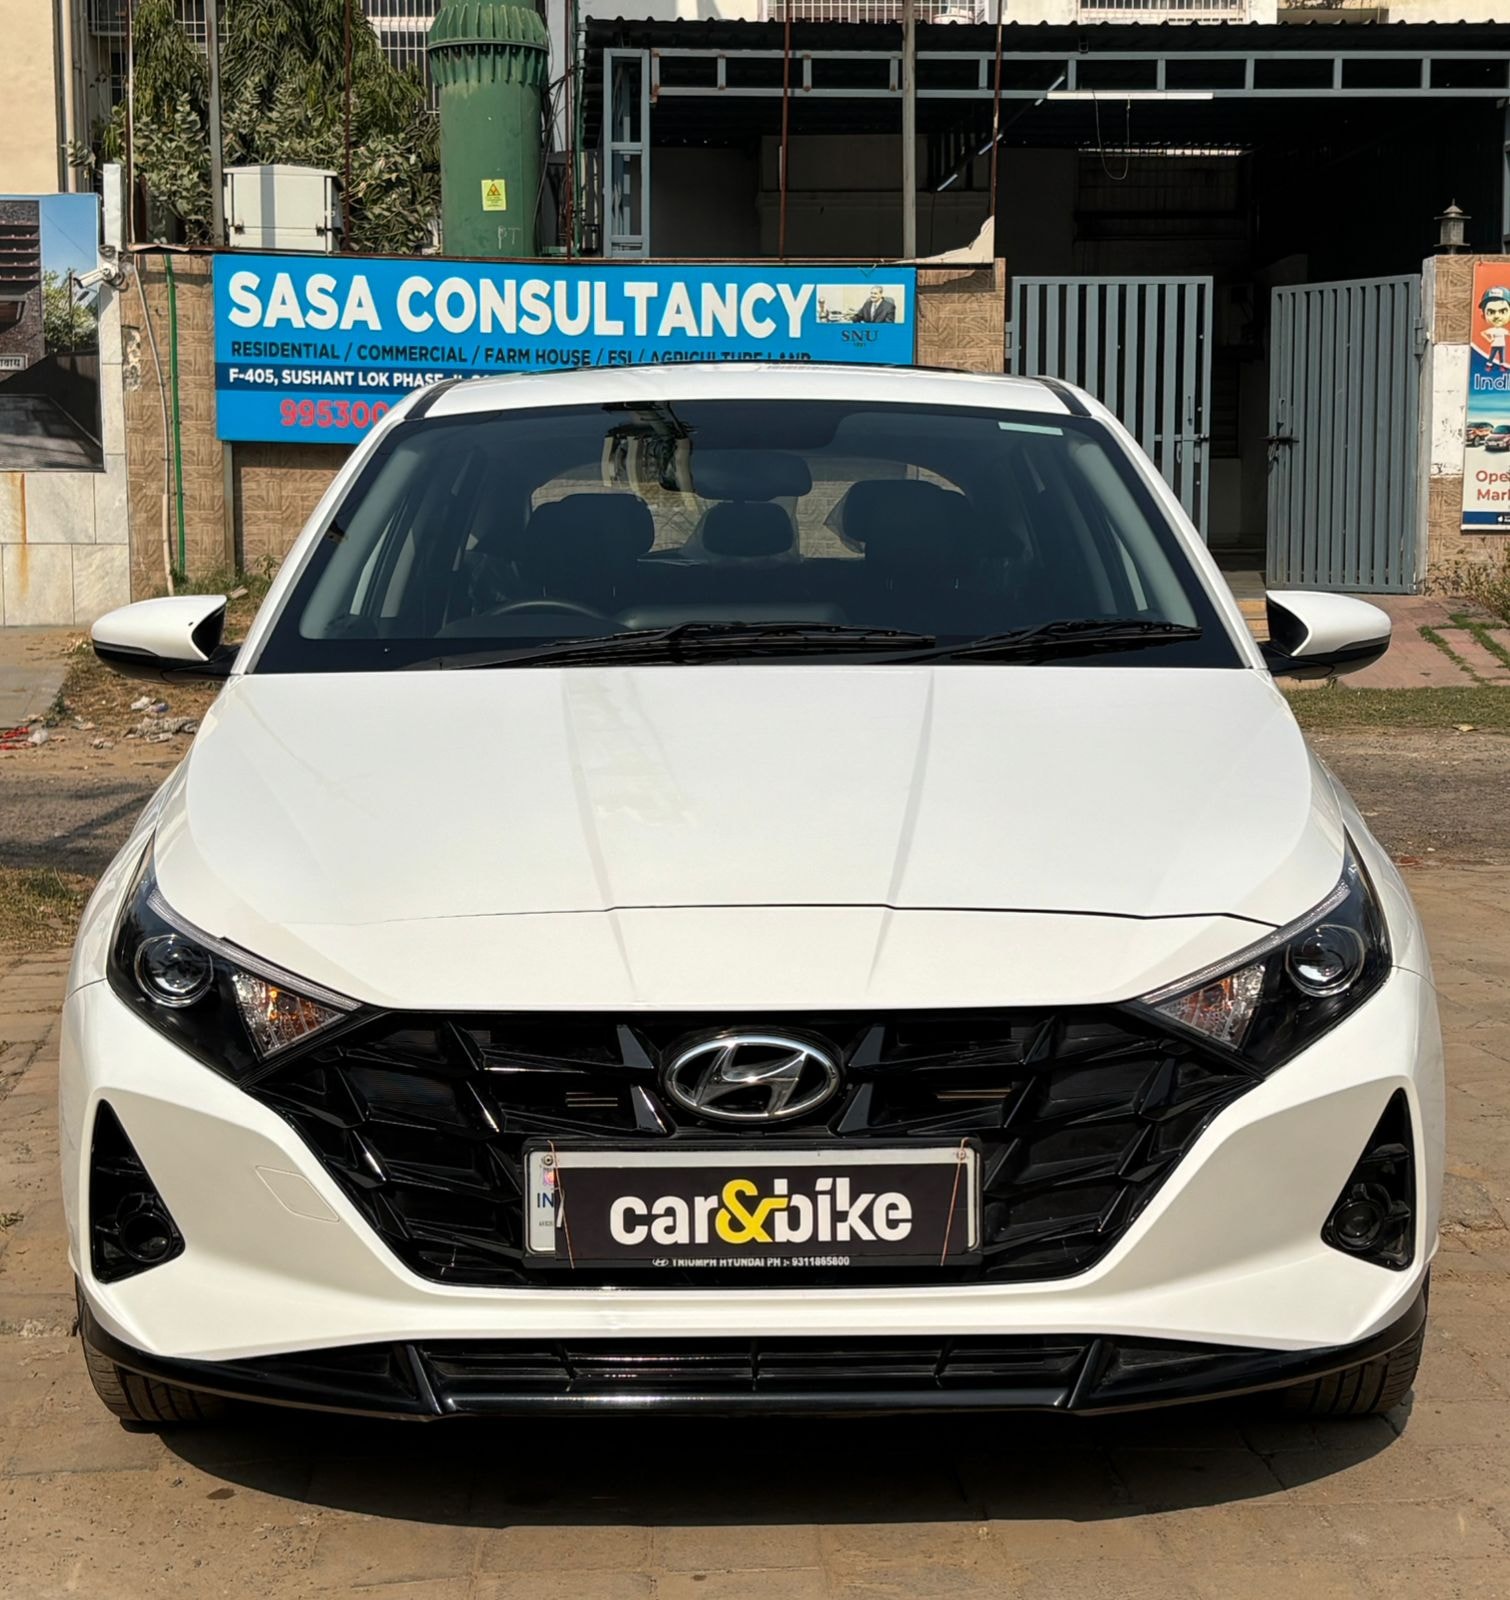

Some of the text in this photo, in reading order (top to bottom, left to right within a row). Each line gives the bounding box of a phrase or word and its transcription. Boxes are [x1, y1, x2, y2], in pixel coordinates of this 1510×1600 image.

[228, 271, 815, 338] SASA CONSULTANCY
[841, 329, 879, 342] SNU
[231, 341, 340, 360] RESIDENTIAL
[357, 345, 467, 362] COMMERCIAL
[485, 348, 530, 364] FARM
[536, 349, 591, 366] HOUSE
[229, 368, 279, 386] F-405,
[282, 370, 354, 385] SUSHANT
[358, 372, 390, 387] LOK
[1474, 373, 1510, 390] Ind
[1476, 470, 1510, 485] Ope
[1477, 488, 1510, 501] Mar
[672, 1258, 717, 1267] TRIUMPH
[720, 1258, 764, 1267] HYUNDAI
[767, 1257, 781, 1267] PH
